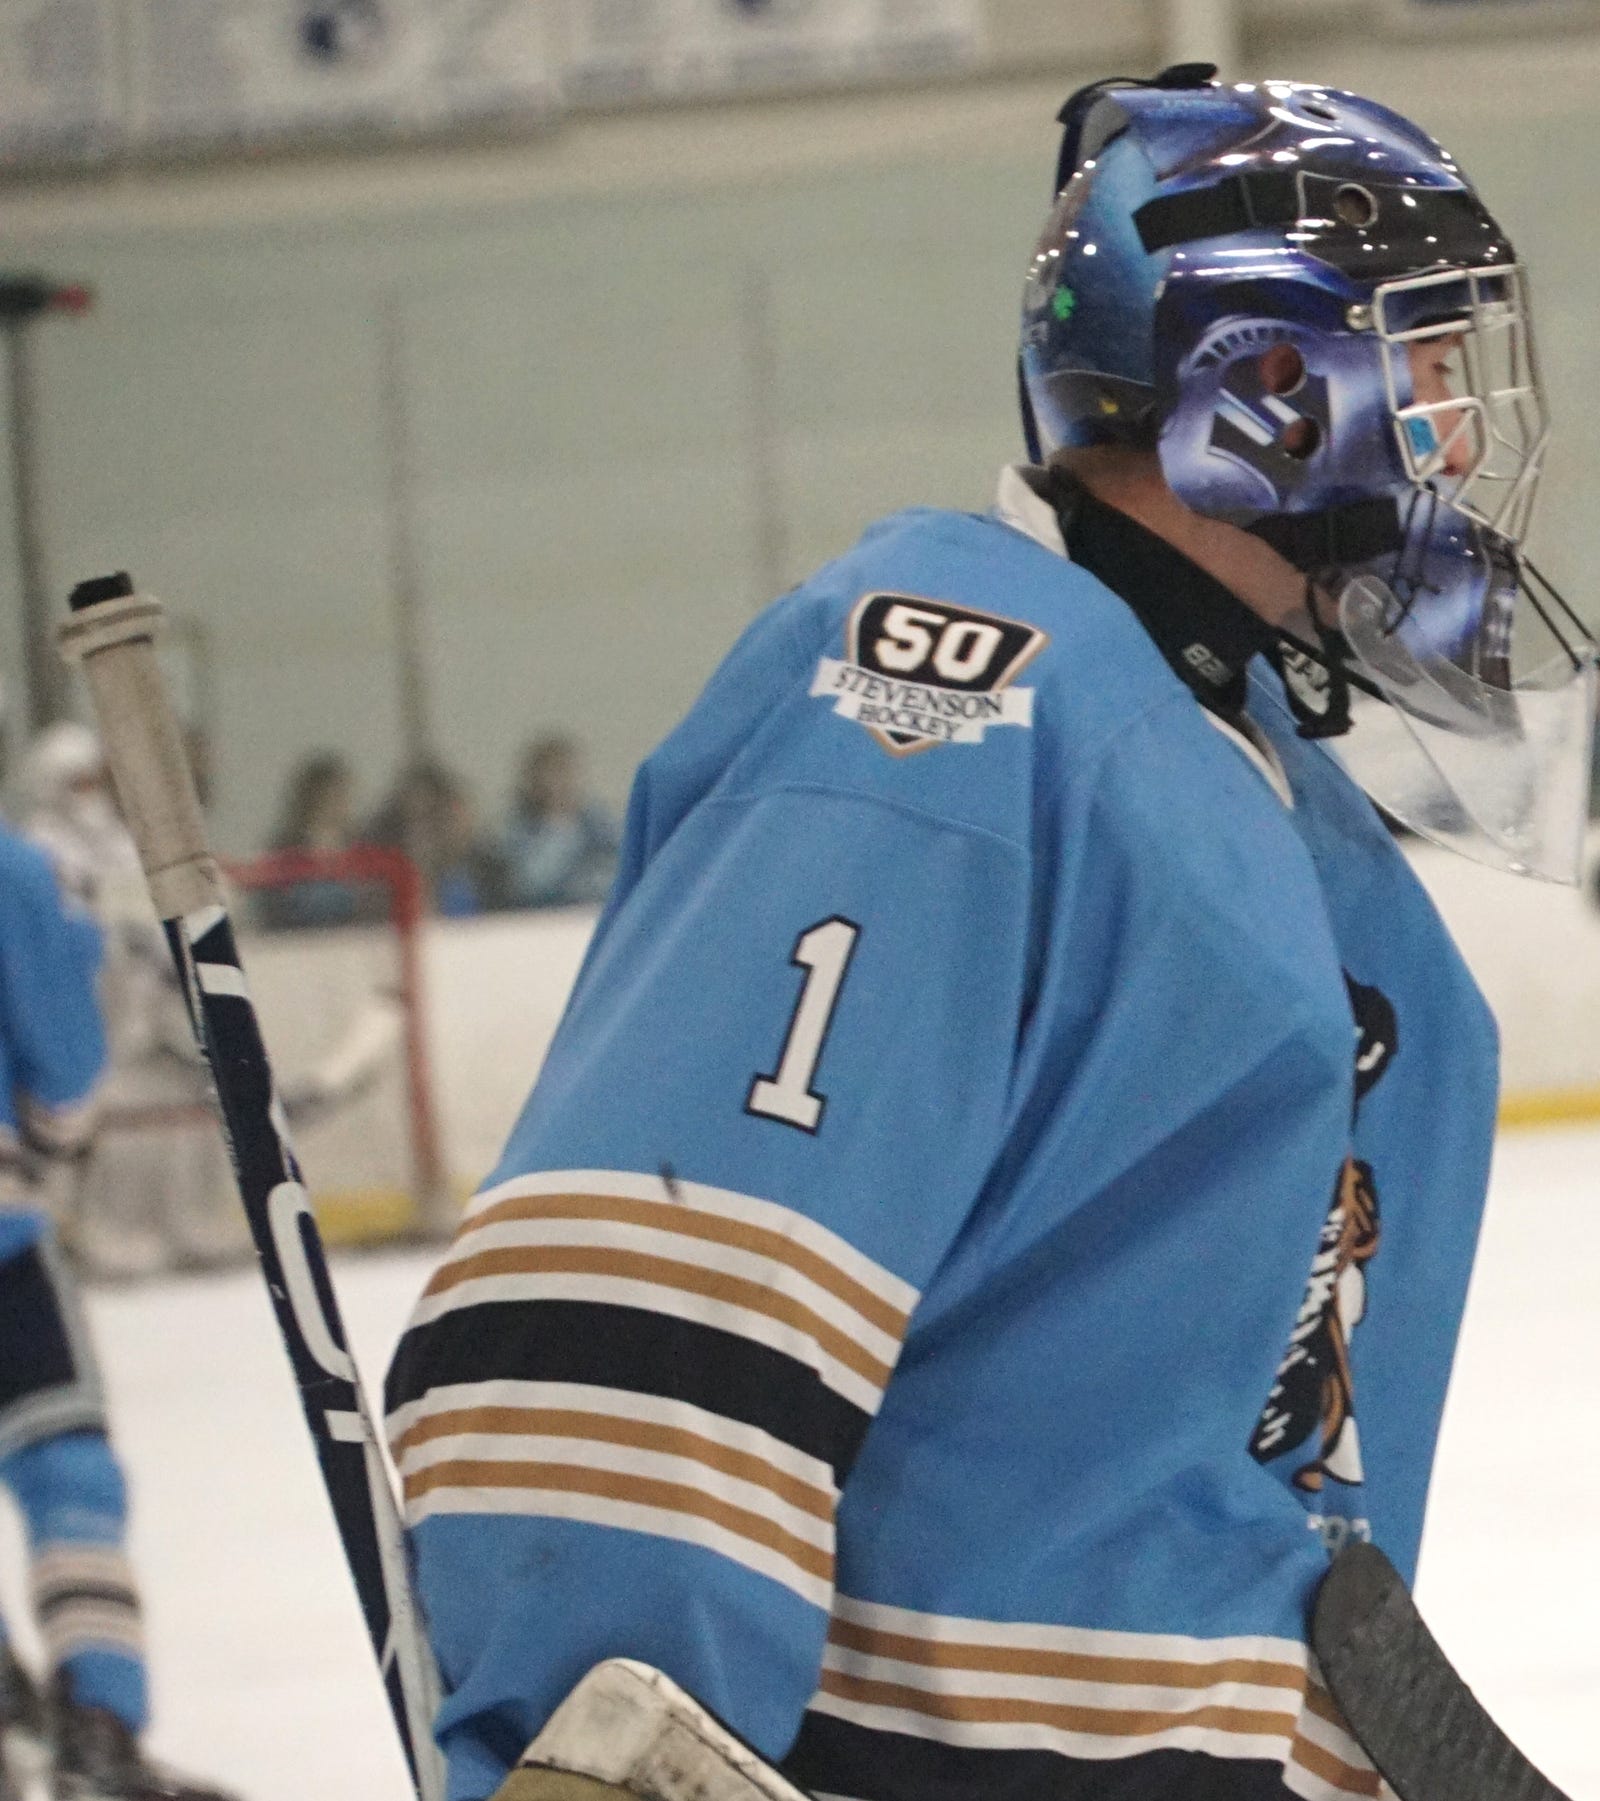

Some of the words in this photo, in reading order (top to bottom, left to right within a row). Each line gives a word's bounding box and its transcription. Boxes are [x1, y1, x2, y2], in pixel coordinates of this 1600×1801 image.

[874, 603, 1003, 682] 50
[832, 664, 1003, 719] STEVENSON
[857, 702, 962, 739] HOCKEY
[743, 913, 863, 1138] 1
